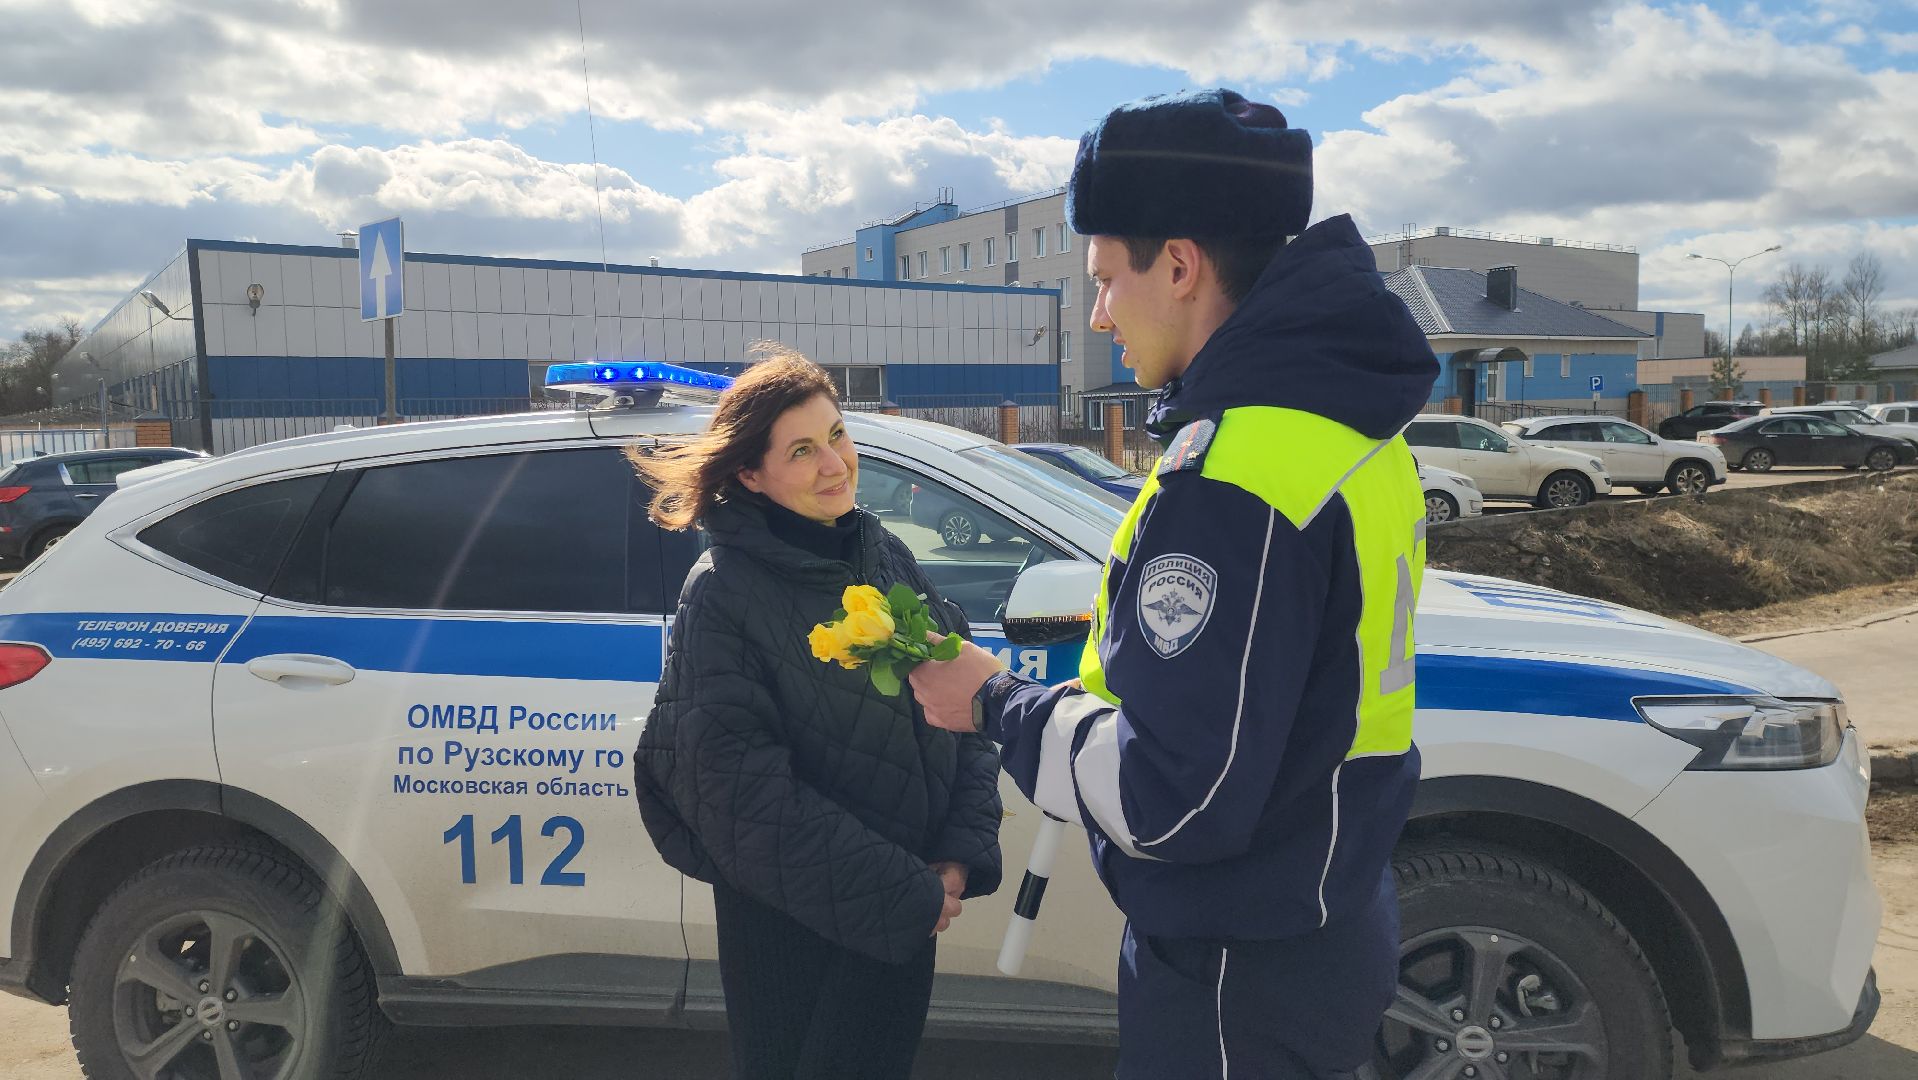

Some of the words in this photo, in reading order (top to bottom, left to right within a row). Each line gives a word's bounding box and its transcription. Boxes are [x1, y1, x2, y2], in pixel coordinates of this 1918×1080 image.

[1592, 377, 1601, 390] P
[1146, 560, 1211, 585] ПОЛИЦИЯ
[1147, 575, 1203, 601] РОССИЯ
[77, 620, 149, 632] ТЕЛЕФОН
[149, 621, 229, 634] ДОВЕРИЯ
[71, 637, 112, 650] (495)
[113, 638, 143, 649] 692
[153, 639, 175, 650] 70
[185, 640, 207, 651] 66
[407, 703, 499, 735] ОМВД
[508, 704, 617, 732] России
[398, 746, 434, 765] по
[444, 740, 585, 774] Рузскому
[594, 748, 624, 768] го
[393, 774, 528, 795] Московская
[536, 776, 630, 797] область
[442, 813, 586, 886] 112
